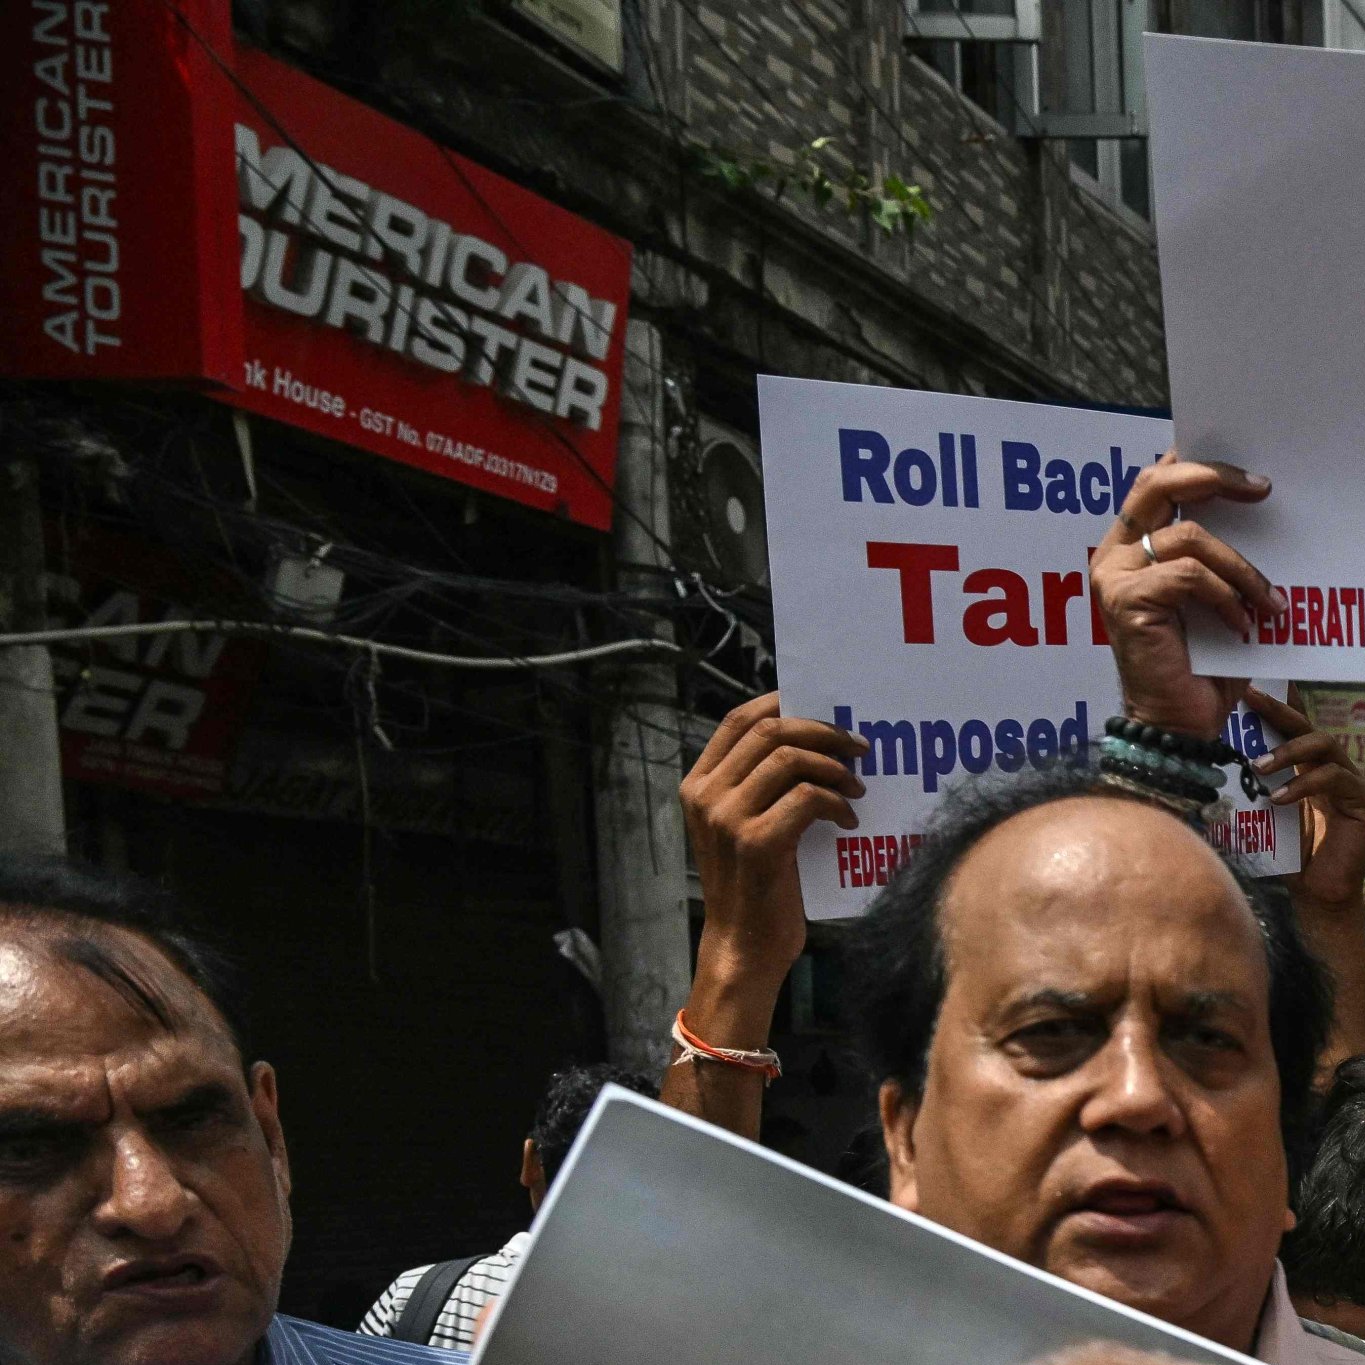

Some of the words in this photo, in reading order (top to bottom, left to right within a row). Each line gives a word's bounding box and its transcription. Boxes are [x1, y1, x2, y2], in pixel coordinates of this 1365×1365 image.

[32, 0, 80, 353] AMERICAN
[74, 0, 122, 356] TOURISTER
[234, 122, 617, 362] MERICAN
[238, 213, 609, 432] URISTER
[273, 366, 347, 418] House
[359, 407, 395, 437] GST
[838, 428, 980, 509] Roll
[1000, 440, 1142, 516] Back
[834, 700, 1089, 793] Imposed
[1234, 805, 1277, 862] (FESTA)
